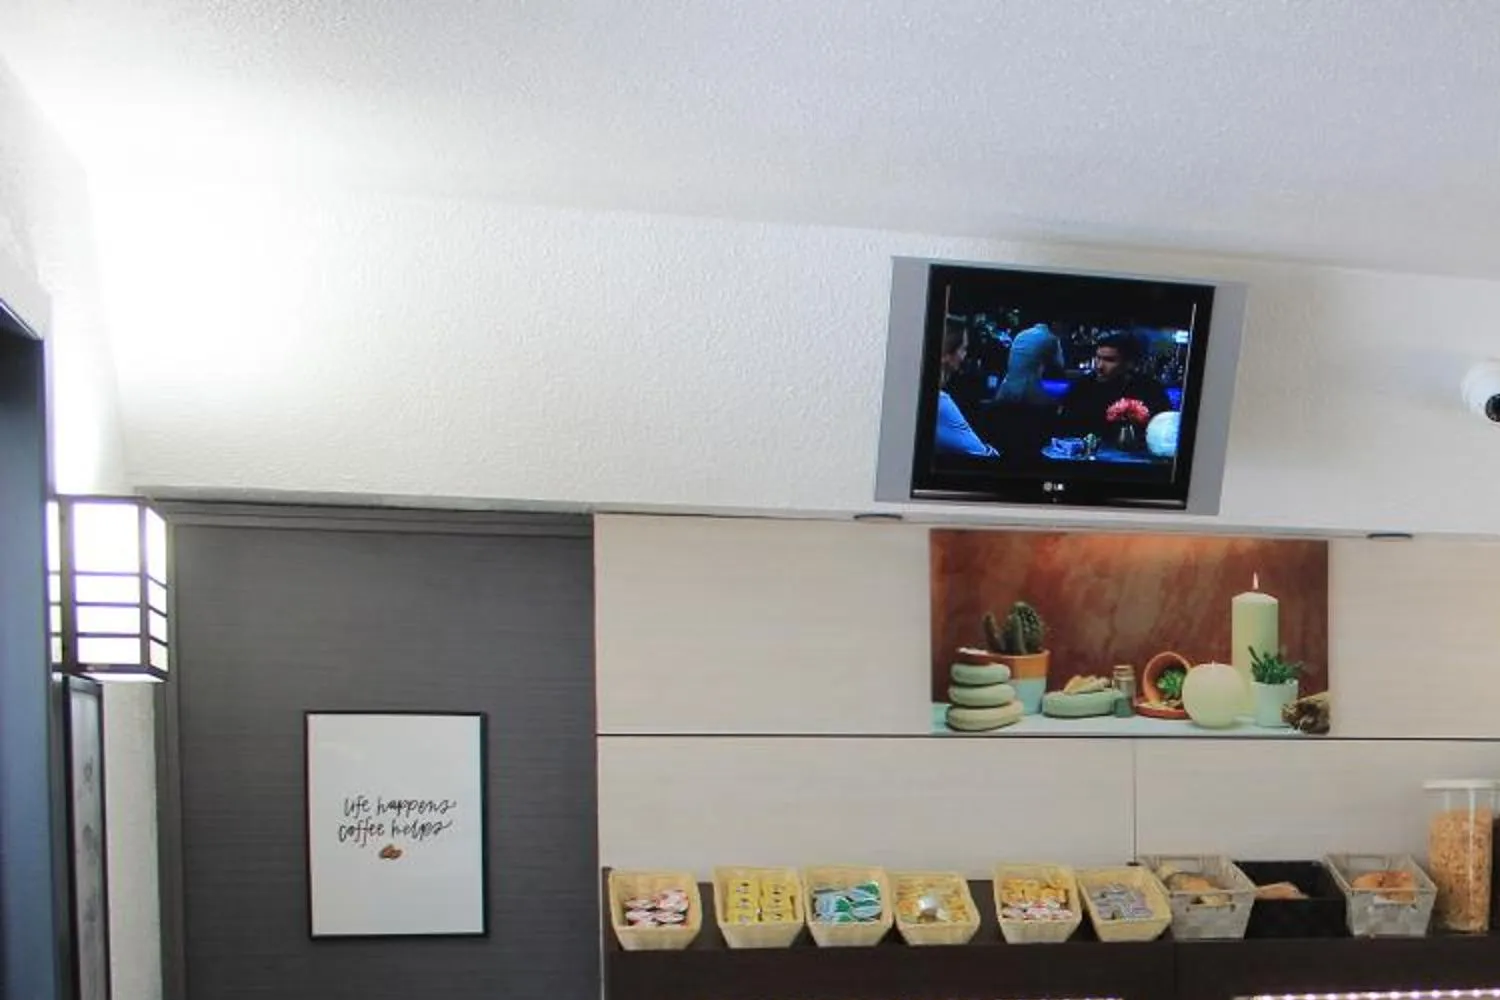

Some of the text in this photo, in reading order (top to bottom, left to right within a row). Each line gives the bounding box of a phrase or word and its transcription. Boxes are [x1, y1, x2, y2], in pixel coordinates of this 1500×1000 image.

[376, 796, 457, 818] happens
[338, 816, 453, 848] coffee helps
